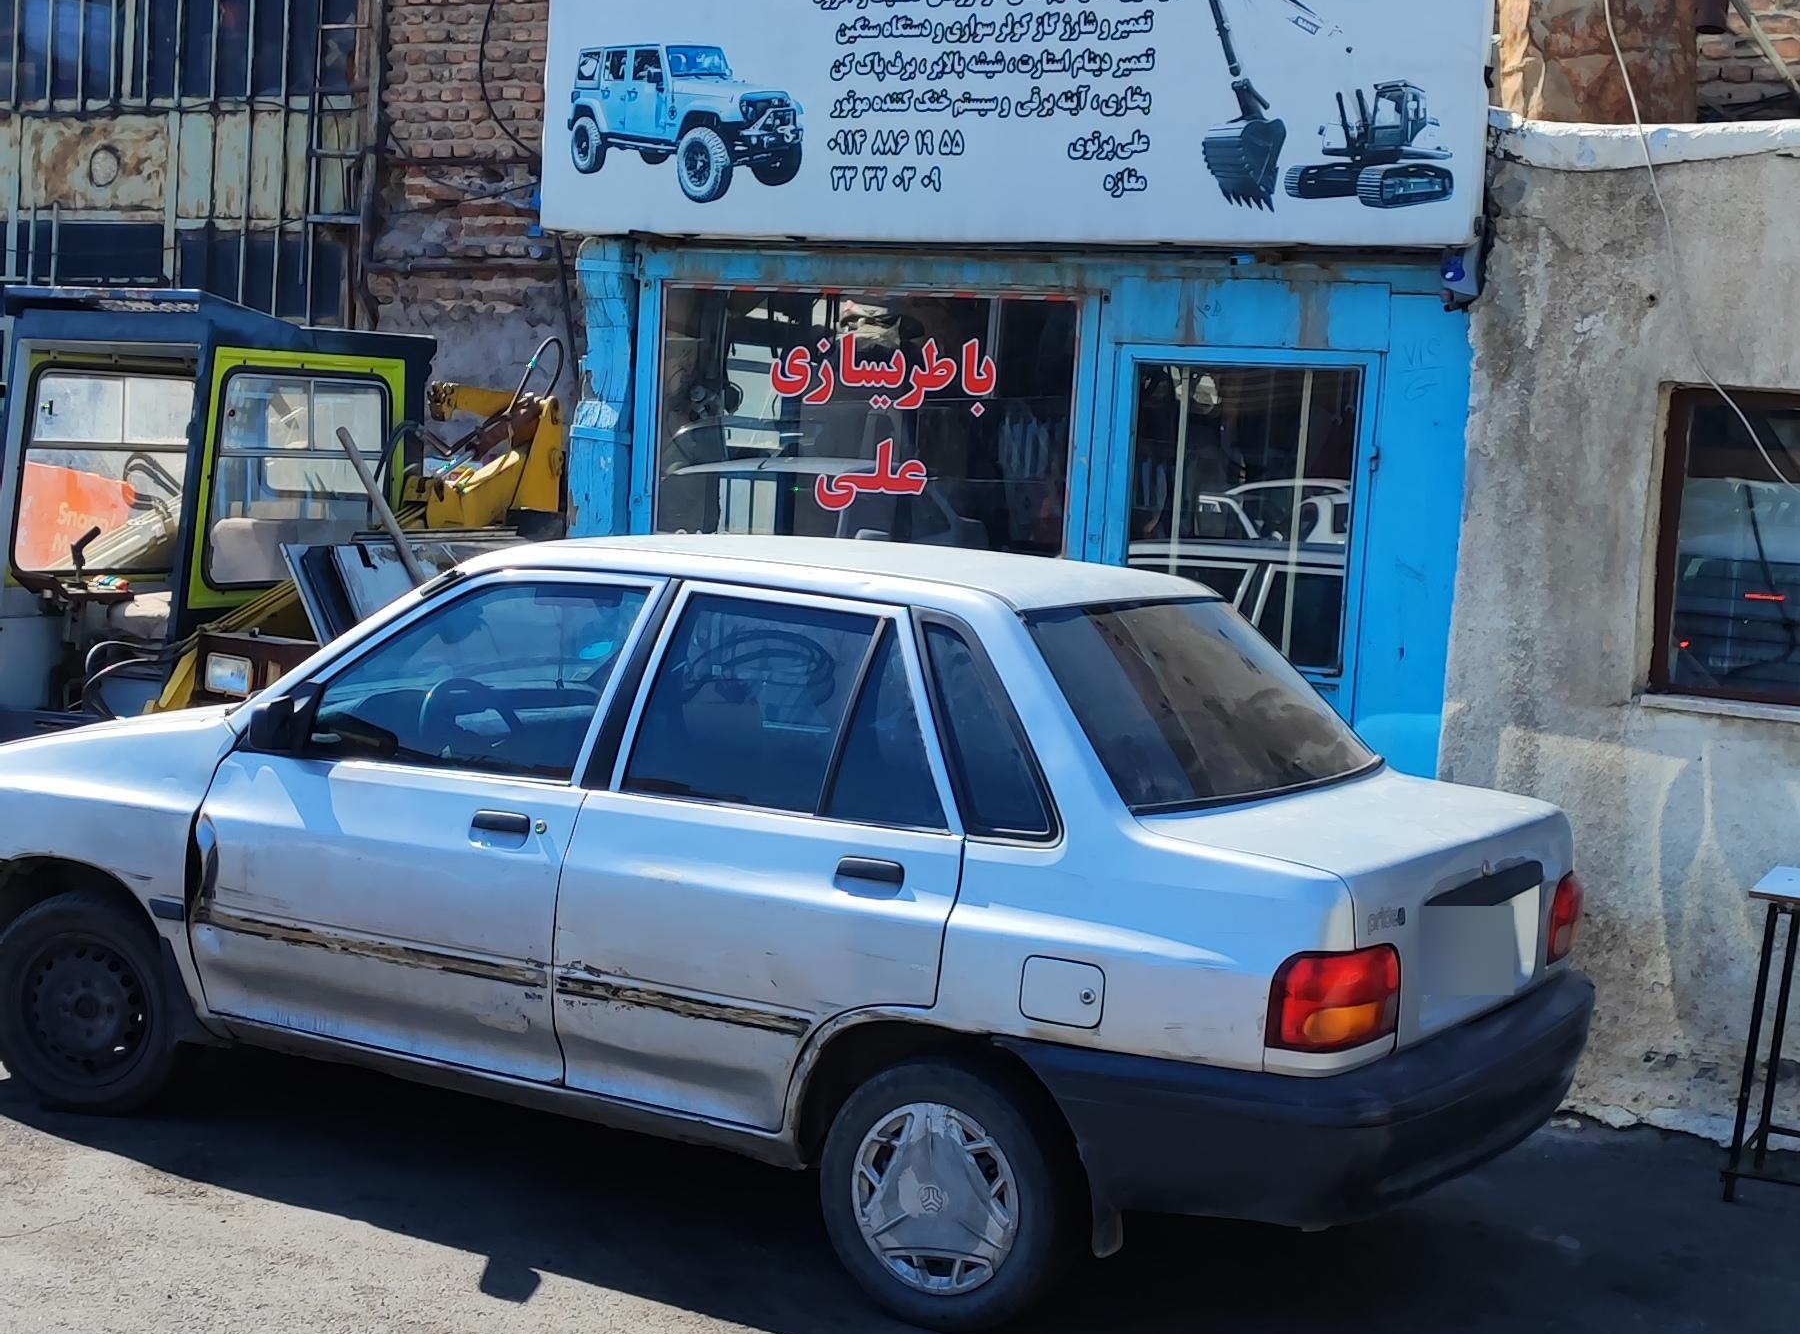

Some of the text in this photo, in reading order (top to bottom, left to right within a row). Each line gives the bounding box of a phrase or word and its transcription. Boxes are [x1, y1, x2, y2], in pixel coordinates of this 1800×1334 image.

[835, 15, 883, 46] سنگین
[880, 14, 933, 39] دستگاه
[931, 21, 946, 45] و
[943, 12, 997, 44] سواری
[994, 11, 1034, 44] کولر
[1058, 9, 1099, 42] شارژ
[1097, 18, 1111, 41] و
[1110, 9, 1155, 41] تعمیر
[829, 51, 856, 82] کن
[854, 51, 888, 83] پاک
[885, 50, 918, 82] برف
[965, 50, 1007, 80] شیشه
[1070, 47, 1113, 80] دینام
[1111, 47, 1156, 79] تعمیر
[829, 89, 874, 119] موتور
[913, 88, 953, 113] خنک
[951, 91, 999, 119] سیستم
[997, 95, 1012, 119] و
[1014, 85, 1058, 118] برقی
[1054, 84, 1091, 117] آینه
[826, 128, 965, 156] ۰۹۱۴ ۸۸۶ ۱۹ ۵۵
[1114, 128, 1151, 161] علی
[920, 165, 942, 193] ۰۹
[1102, 166, 1148, 199] مغازه
[770, 332, 998, 418] باطریسازی
[813, 437, 928, 512] علی
